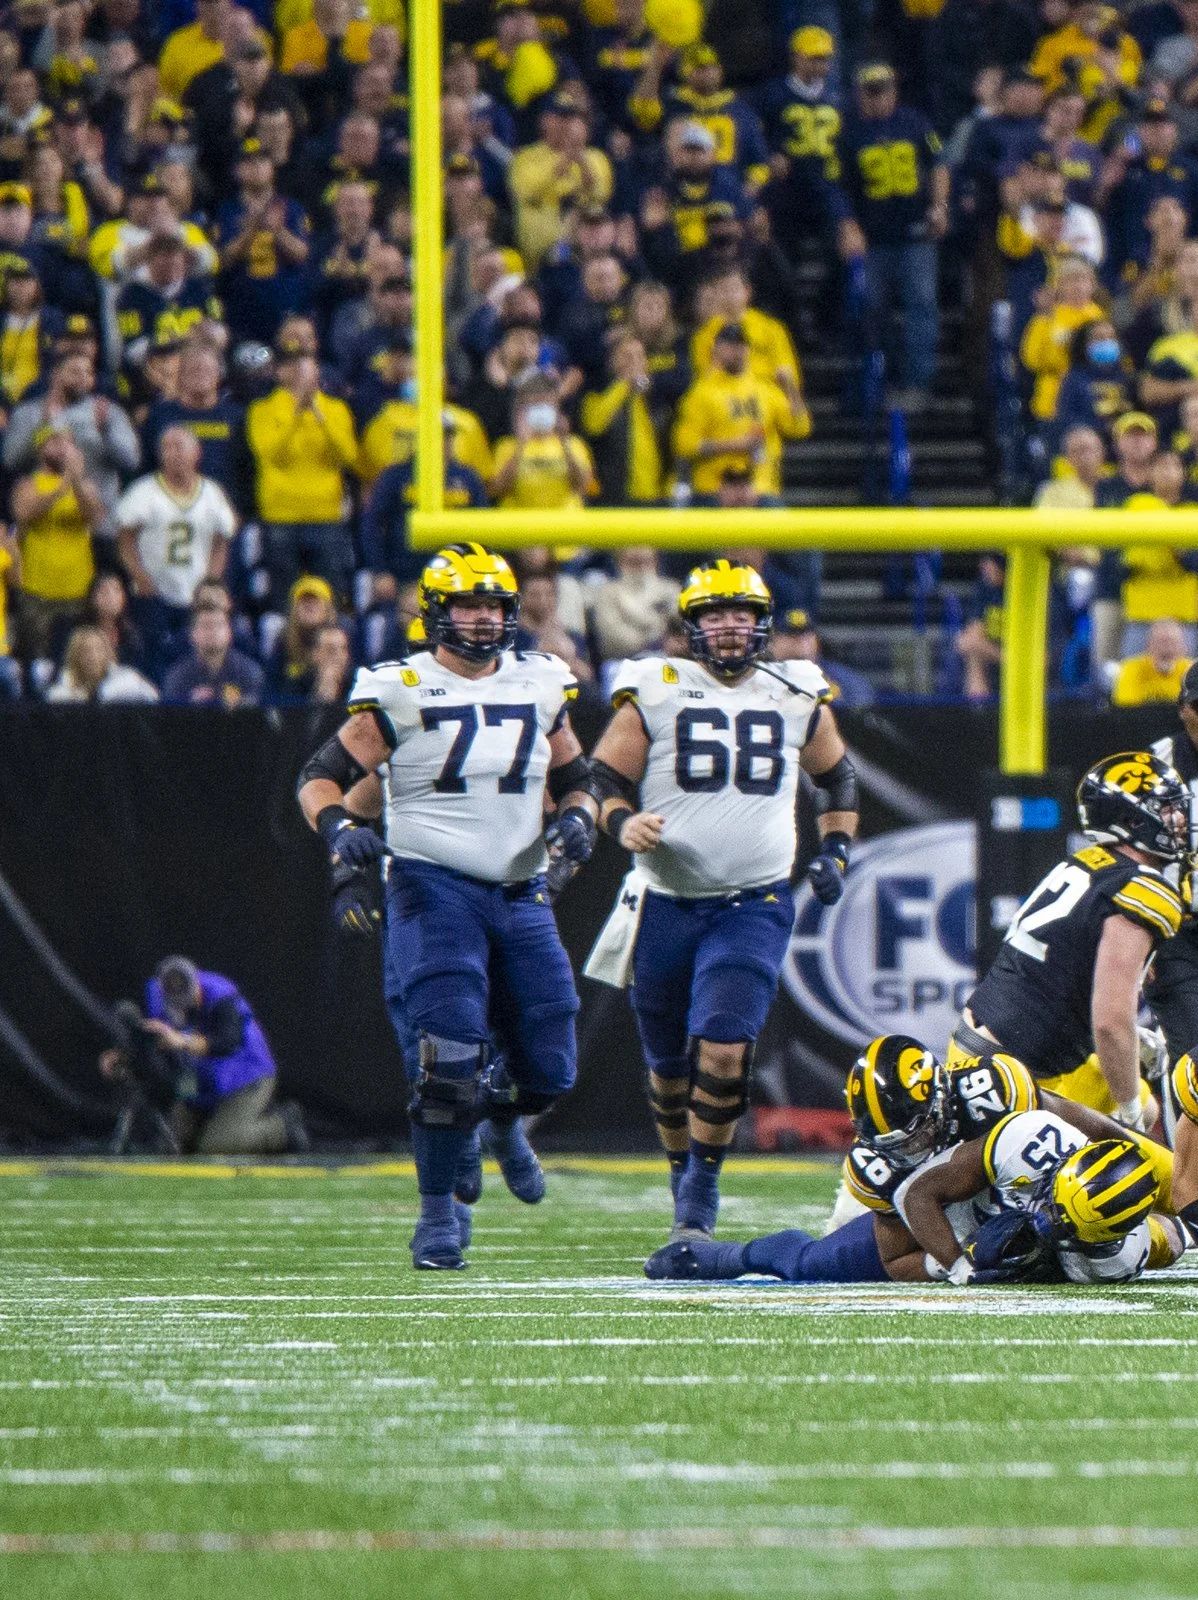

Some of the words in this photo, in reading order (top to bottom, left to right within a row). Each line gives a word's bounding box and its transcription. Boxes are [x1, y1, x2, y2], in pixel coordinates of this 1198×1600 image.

[167, 521, 194, 567] 2
[420, 703, 538, 794] 77
[675, 707, 785, 796] 68
[957, 1068, 1006, 1122] 26
